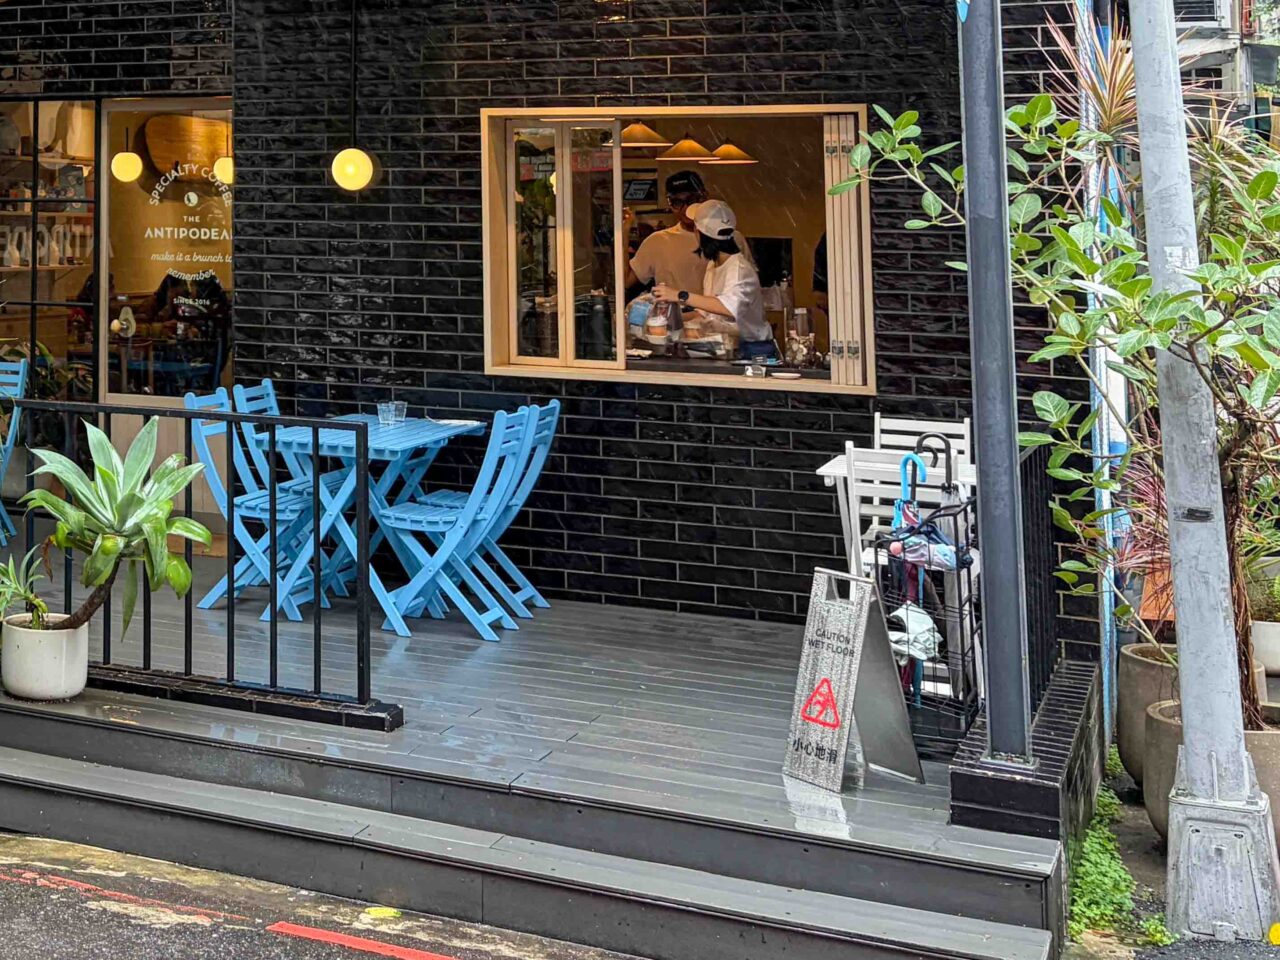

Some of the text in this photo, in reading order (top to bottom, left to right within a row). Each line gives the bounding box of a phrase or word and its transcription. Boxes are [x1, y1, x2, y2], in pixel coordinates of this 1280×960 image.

[149, 163, 199, 206] SPECIALTY
[183, 215, 201, 223] THE
[144, 227, 233, 240] ANTIPODEA
[151, 251, 174, 262] make
[176, 251, 183, 262] it
[184, 253, 191, 262] a
[192, 251, 224, 263] brunch
[166, 267, 216, 281] remember
[195, 297, 210, 306] 2016
[815, 628, 851, 645] CAUTION
[808, 637, 855, 658] WET FLOOR
[792, 738, 838, 764] 小心地滑
